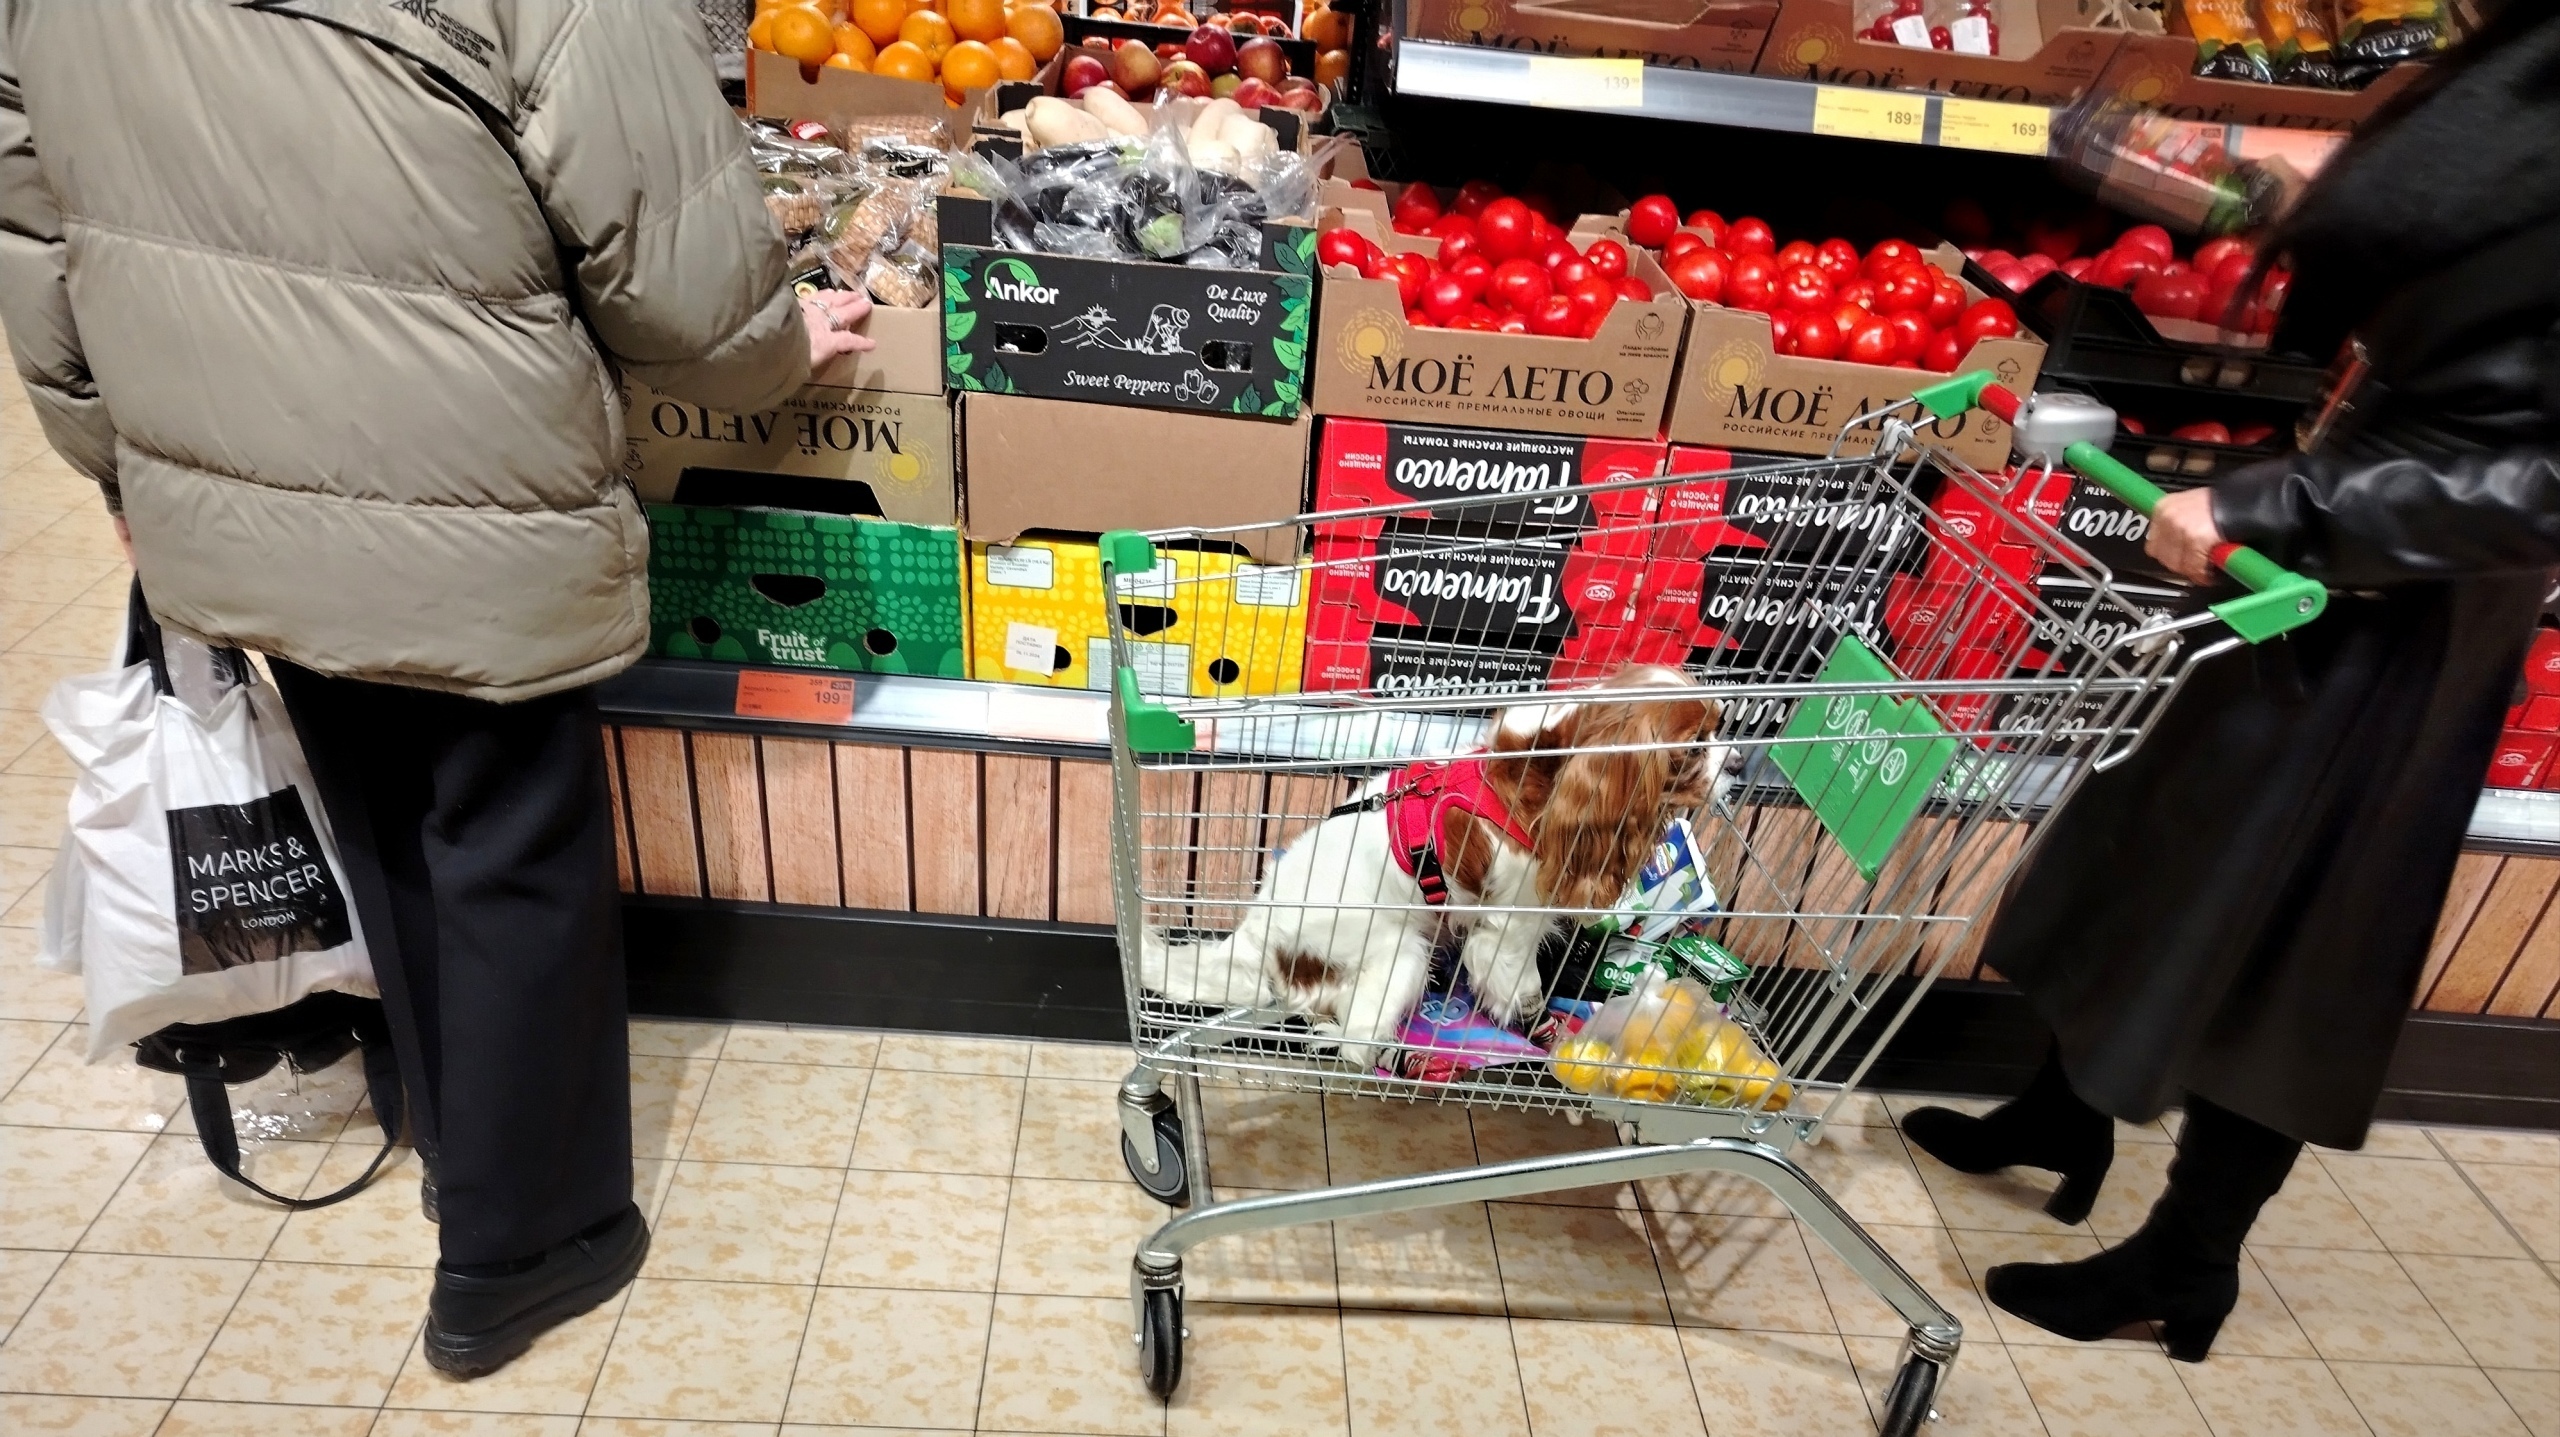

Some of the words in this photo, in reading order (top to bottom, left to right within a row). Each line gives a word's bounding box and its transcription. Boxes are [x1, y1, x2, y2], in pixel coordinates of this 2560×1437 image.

[1603, 75, 1630, 91] 139
[1886, 110, 1912, 126] 189
[2011, 122, 2037, 137] 169
[985, 274, 1060, 305] Ankor
[1206, 283, 1229, 301] De
[1231, 285, 1268, 304] Luxe
[1206, 302, 1262, 326] Quality
[1063, 369, 1110, 389] Sweet
[1113, 373, 1172, 395] Peppers
[1365, 353, 1476, 397] МОЁ
[813, 399, 901, 416] РОССИЙСКИЕ
[1365, 395, 1452, 410] РОССИЙСКИЕ
[1457, 402, 1553, 418] ПРЕМИАЛЬНЫЕ
[1558, 408, 1606, 422] ОВОЩИ
[1725, 383, 1834, 427] МОЁ
[797, 412, 904, 457] МОЁ
[1723, 422, 1805, 440] РОССИЙСКИЕ
[1402, 434, 1450, 448] ТОМАТЫ
[1453, 438, 1503, 452] КРАСНЫЕ
[1506, 442, 1575, 456] НАСТОЯЩИЕ
[1338, 460, 1382, 470] ВЫРАЩЕНО
[1344, 452, 1374, 463] РОССИИ
[1395, 457, 1579, 515] Flamenco
[1490, 553, 1556, 568] НАСТОЯЩИЕ
[1384, 567, 1561, 624] Flamenco
[757, 628, 810, 649] Fruit
[813, 636, 828, 647] of
[770, 646, 827, 662] trust
[1478, 660, 1542, 673] НАСТОЯЩИЕ
[814, 690, 840, 705] 199
[187, 841, 285, 880] MARKS
[286, 836, 310, 860] &
[190, 863, 326, 914] SPENCER
[241, 910, 298, 930] LONDON
